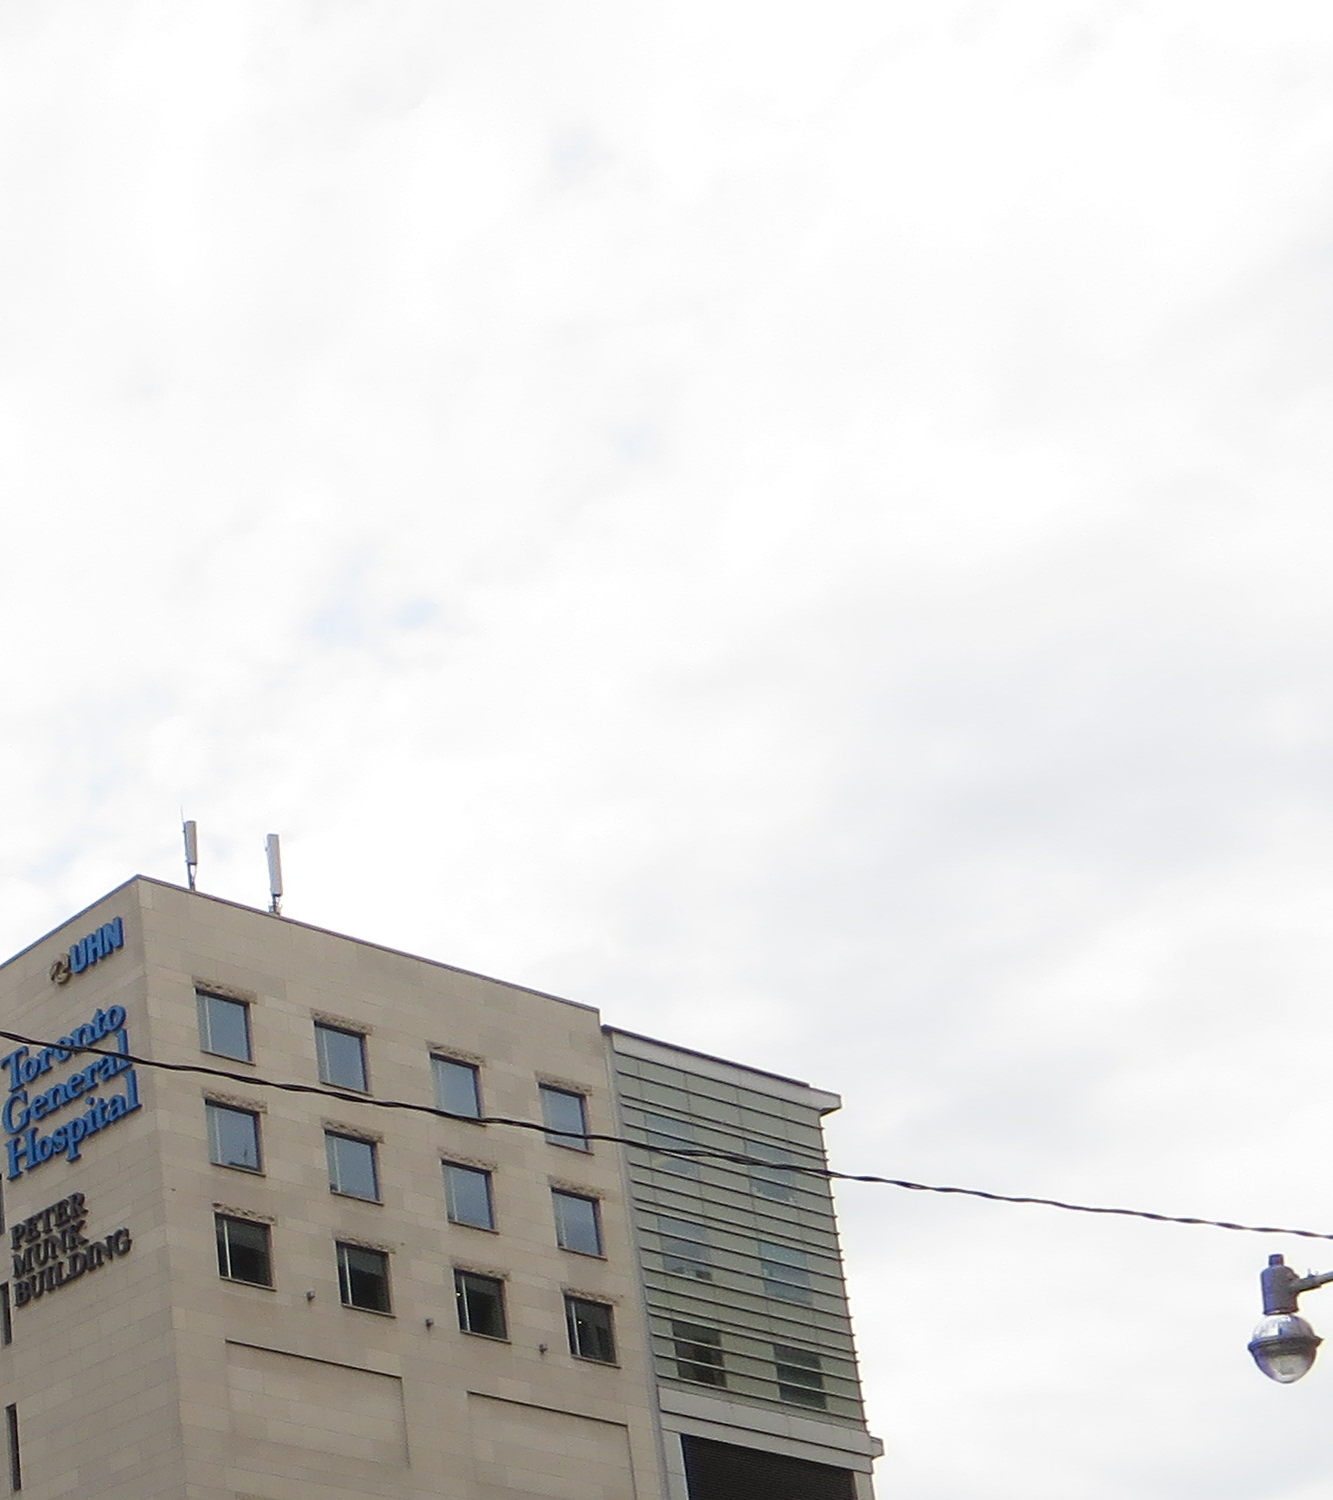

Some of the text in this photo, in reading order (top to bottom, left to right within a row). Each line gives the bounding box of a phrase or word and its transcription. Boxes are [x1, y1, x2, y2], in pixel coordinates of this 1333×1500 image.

[70, 917, 123, 975] UHN
[0, 1003, 128, 1094] Toronto
[2, 1028, 134, 1136] General
[5, 1069, 142, 1180] Hospital
[10, 1192, 89, 1251] PETER
[12, 1219, 89, 1279] MUNK
[14, 1228, 133, 1308] BUILDING
